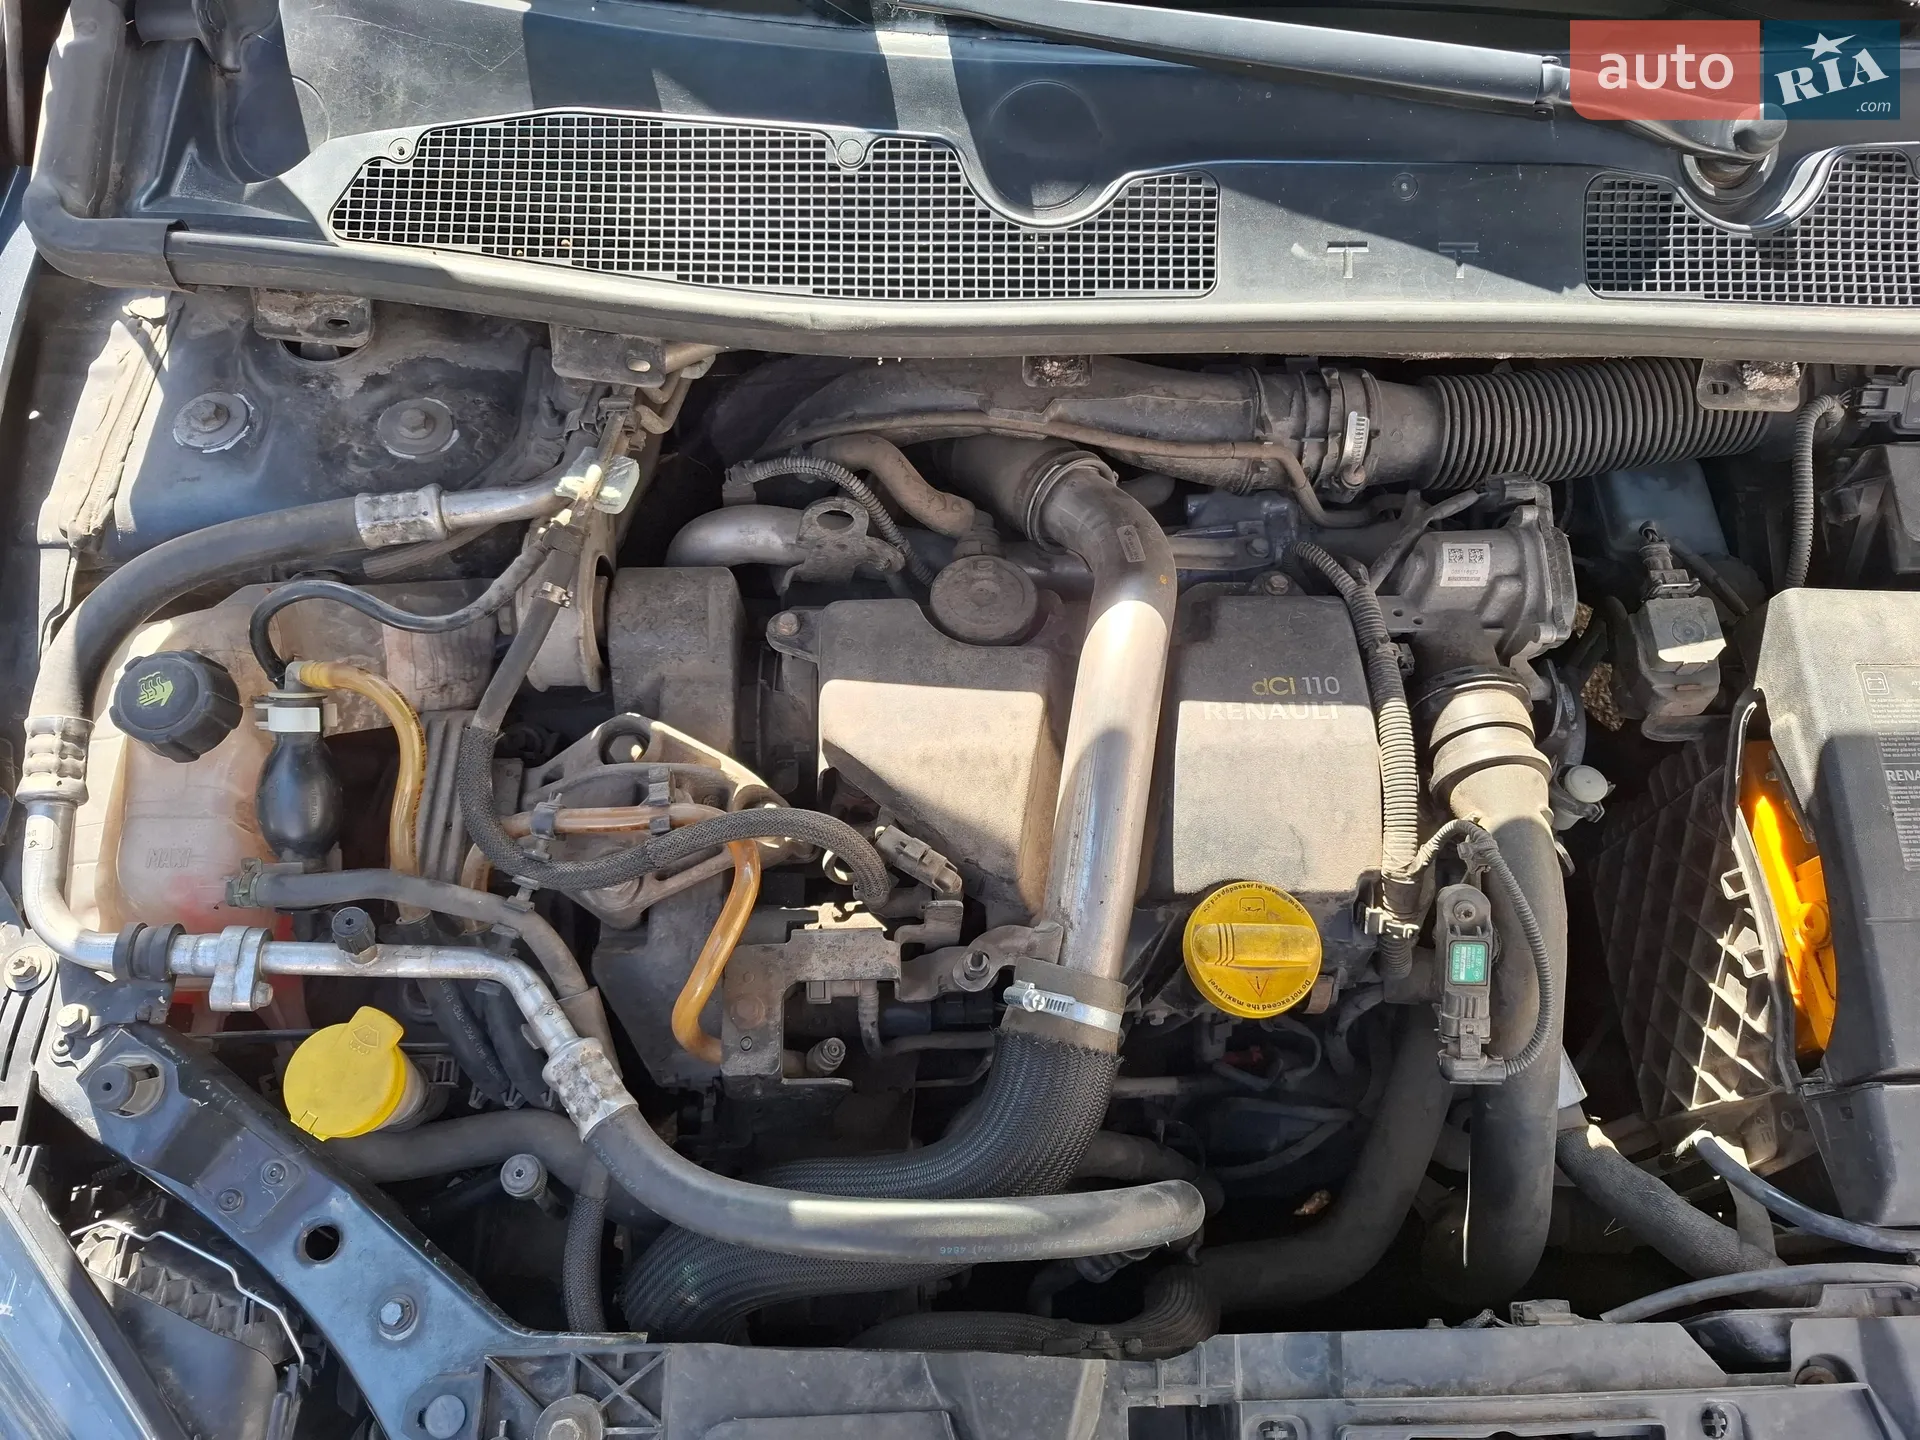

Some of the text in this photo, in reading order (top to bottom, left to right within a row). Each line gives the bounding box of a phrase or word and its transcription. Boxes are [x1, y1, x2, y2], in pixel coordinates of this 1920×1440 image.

[1301, 676, 1340, 694] 110
[1203, 701, 1343, 720] RENAULT
[1885, 769, 1920, 781] RENA
[1255, 882, 1263, 890] le
[1207, 978, 1311, 1011] Do not exceed the maxi level
